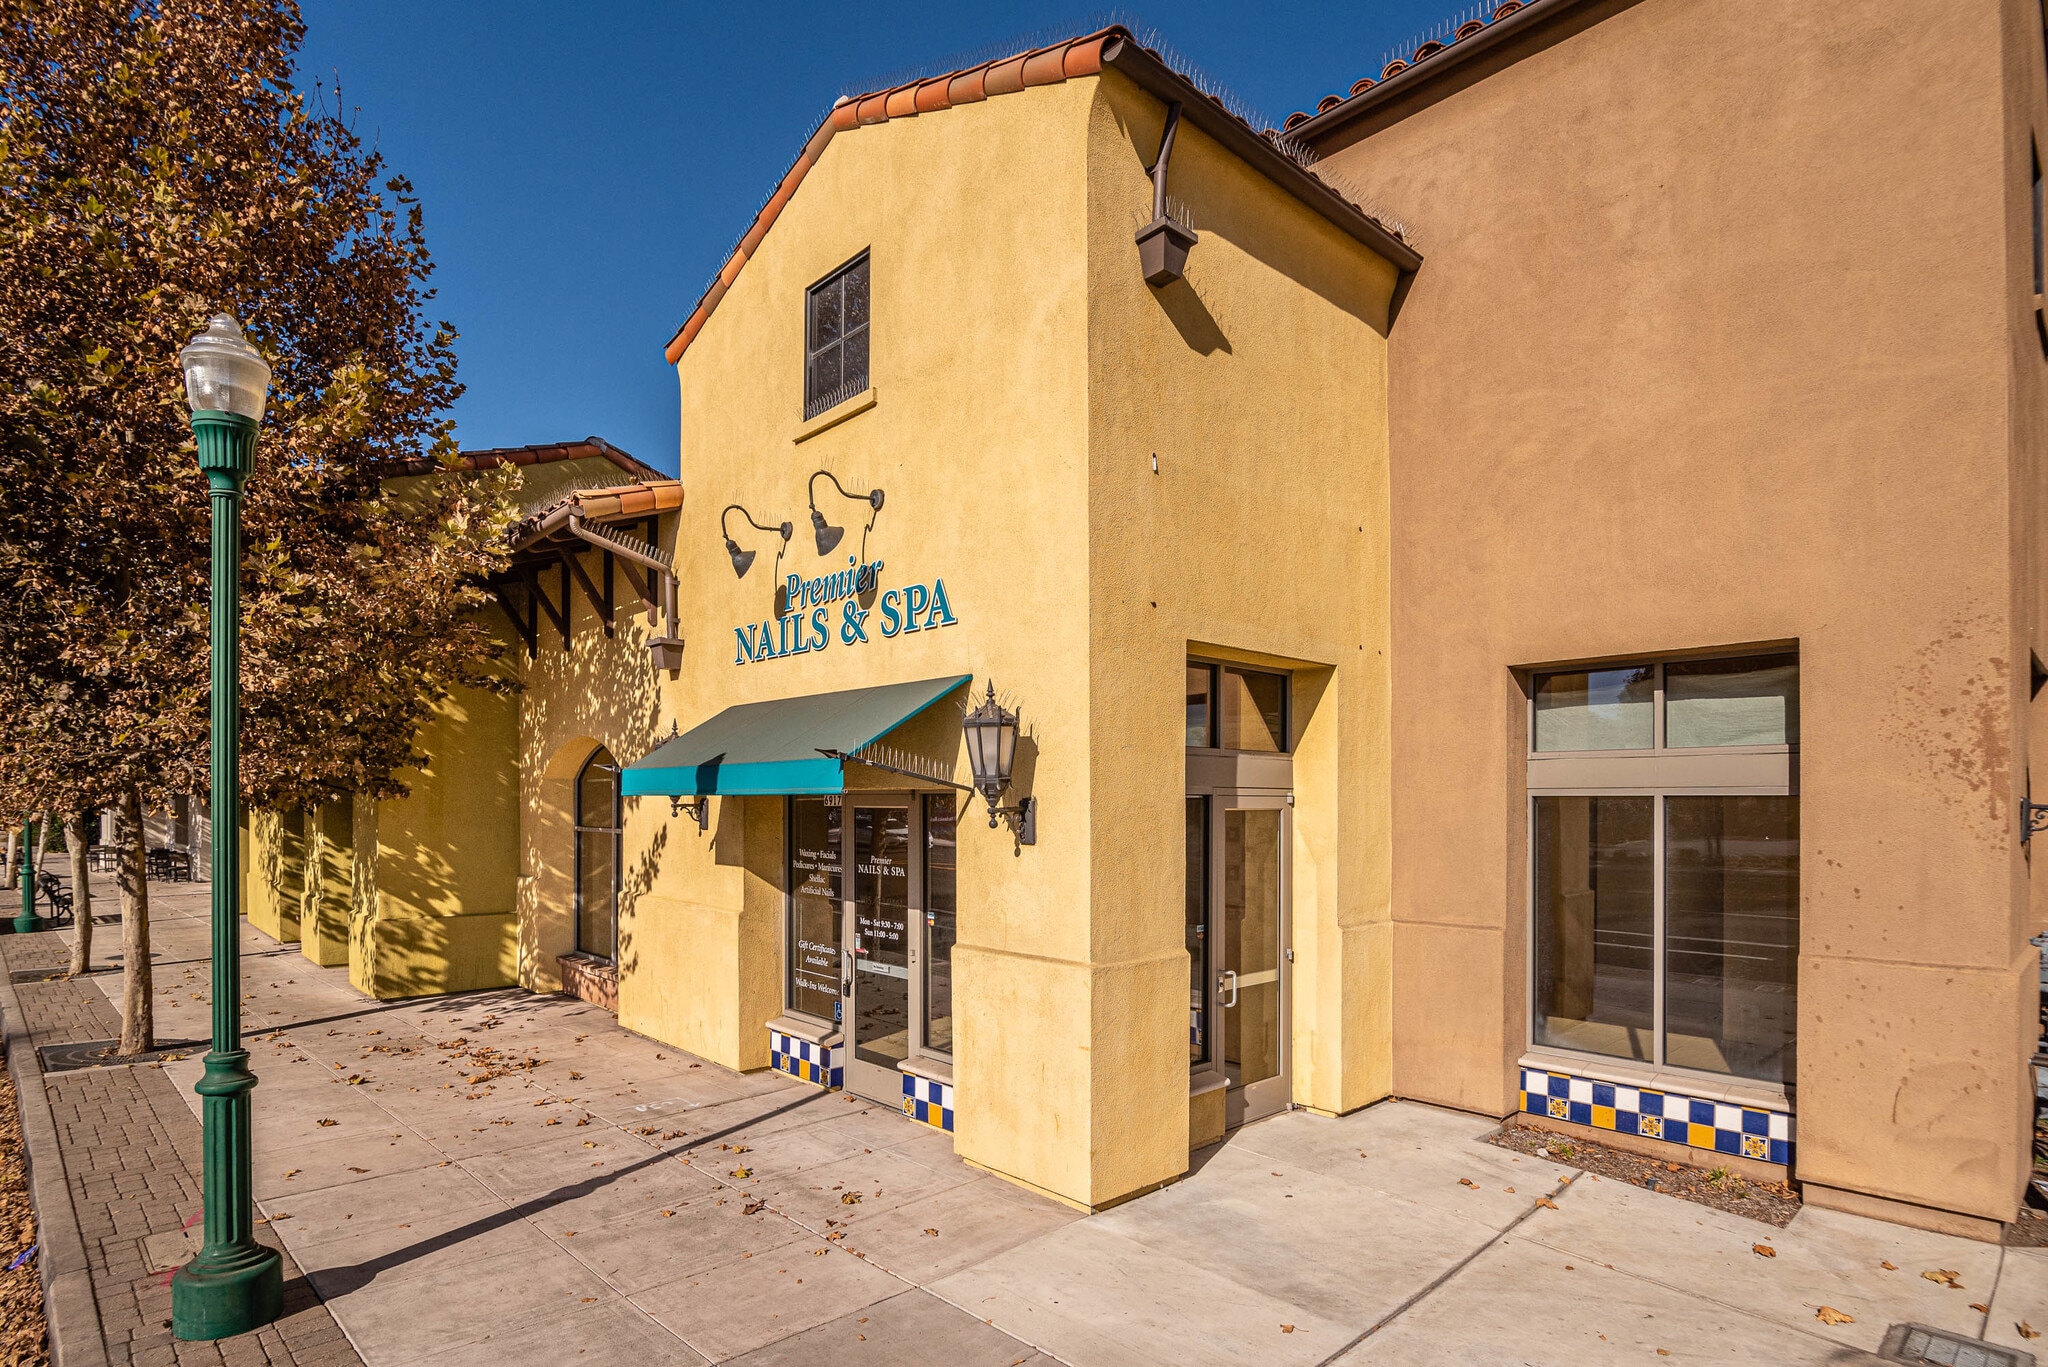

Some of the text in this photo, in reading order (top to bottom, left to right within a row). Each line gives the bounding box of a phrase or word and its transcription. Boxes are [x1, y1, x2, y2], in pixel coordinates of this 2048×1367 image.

[784, 554, 883, 612] Premier
[734, 577, 957, 664] NAILS & SPA
[824, 795, 842, 806] 6917
[799, 848, 836, 860] Waxing Facials
[870, 855, 892, 865] Premier
[793, 860, 815, 870] Pedicures
[858, 864, 905, 877] NAILS & SPA
[809, 873, 825, 883] Shellac
[800, 885, 834, 897] Artificial Nails
[859, 917, 870, 926] Mon
[873, 918, 881, 927] Sat
[881, 919, 890, 928] 9:30
[894, 922, 904, 931] 7:00
[864, 928, 873, 937] Sun
[874, 929, 885, 938] 11:00
[889, 932, 899, 941] 5:00
[798, 940, 808, 950] Gift
[806, 955, 828, 966] Available
